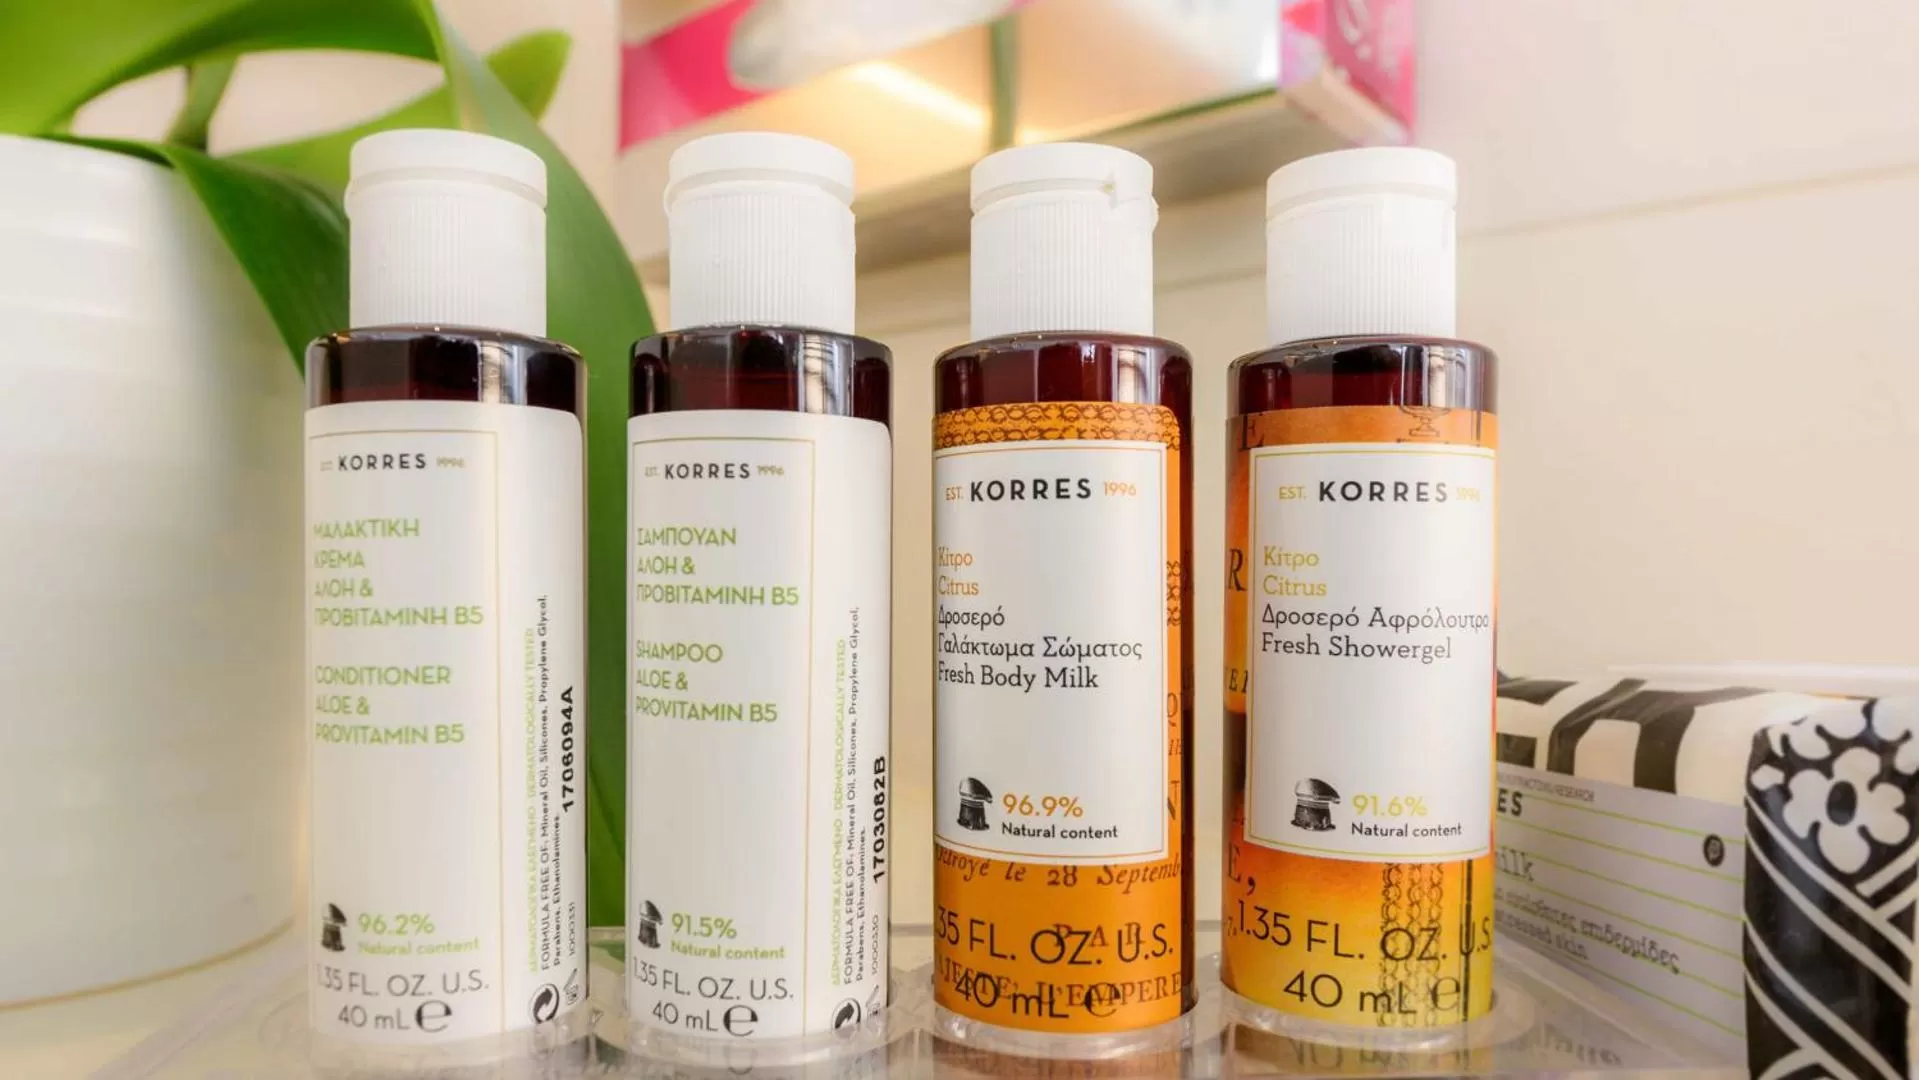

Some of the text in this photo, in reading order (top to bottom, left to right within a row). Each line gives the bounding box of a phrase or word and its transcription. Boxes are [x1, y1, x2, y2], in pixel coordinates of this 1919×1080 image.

[338, 453, 427, 471] KORRES
[664, 463, 751, 480] KORRES
[946, 478, 1137, 501] EST. KORRES 1996
[1279, 485, 1307, 500] EST.
[1318, 480, 1449, 503] KORRES
[681, 556, 696, 576] &
[1263, 546, 1320, 571] Κίτρο
[359, 577, 374, 597] &
[771, 587, 800, 607] B5
[937, 575, 980, 596] Citrus
[1262, 575, 1327, 597] Citrus
[938, 605, 1006, 631] Δροσερό
[1262, 603, 1490, 634] Δροσερό Αφρόλουτρο
[636, 640, 724, 664] SHAMPOO
[938, 632, 1143, 663] Γαλάκτωμα Σώματος
[1262, 632, 1452, 665] Fresh Showergel
[314, 665, 453, 686] CONDITIONER
[537, 641, 549, 702] Propylene
[636, 669, 689, 691] ALOE &
[848, 652, 859, 715] Propylene
[938, 661, 1100, 693] Fresh Body Milk
[315, 694, 371, 716] ALOE &
[636, 696, 778, 723] PROVITAMIN B5
[315, 722, 466, 745] PROVITAMIN B5
[561, 686, 574, 812] 1706094A
[538, 792, 549, 837] Mineral
[872, 755, 886, 883] 1703082B
[1002, 794, 1084, 818] 96.9%
[1352, 794, 1429, 818] 91.6%
[845, 804, 856, 850] Mineral
[1002, 822, 1119, 839] Natural content
[1351, 822, 1463, 838] Natural content
[539, 868, 550, 900] FREE
[844, 881, 855, 914] FREE
[358, 912, 436, 935] 96.2%
[540, 904, 550, 969] FORMULA
[671, 913, 737, 939] 91.5%
[1238, 899, 1292, 947] 1.35
[1306, 919, 1365, 960] FL.
[1380, 927, 1448, 962] OZ.
[357, 937, 481, 956] Natural content
[670, 939, 785, 960] Natural content
[843, 918, 855, 985] FORMULA
[969, 917, 1017, 961] FL.
[1030, 927, 1103, 965] OZ.
[1117, 922, 1174, 963] U.S.
[442, 968, 490, 995] U.S.
[663, 969, 692, 996] FL.
[698, 976, 741, 1000] OZ.
[750, 977, 794, 1000] U.S.
[954, 970, 999, 1008] 40
[1011, 983, 1070, 1019] mL
[1283, 969, 1343, 1008] 40
[1358, 980, 1418, 1015] mL
[338, 1004, 368, 1028] 40
[373, 1008, 412, 1031] mL
[652, 1001, 680, 1025] 40
[685, 1009, 719, 1032] mL
